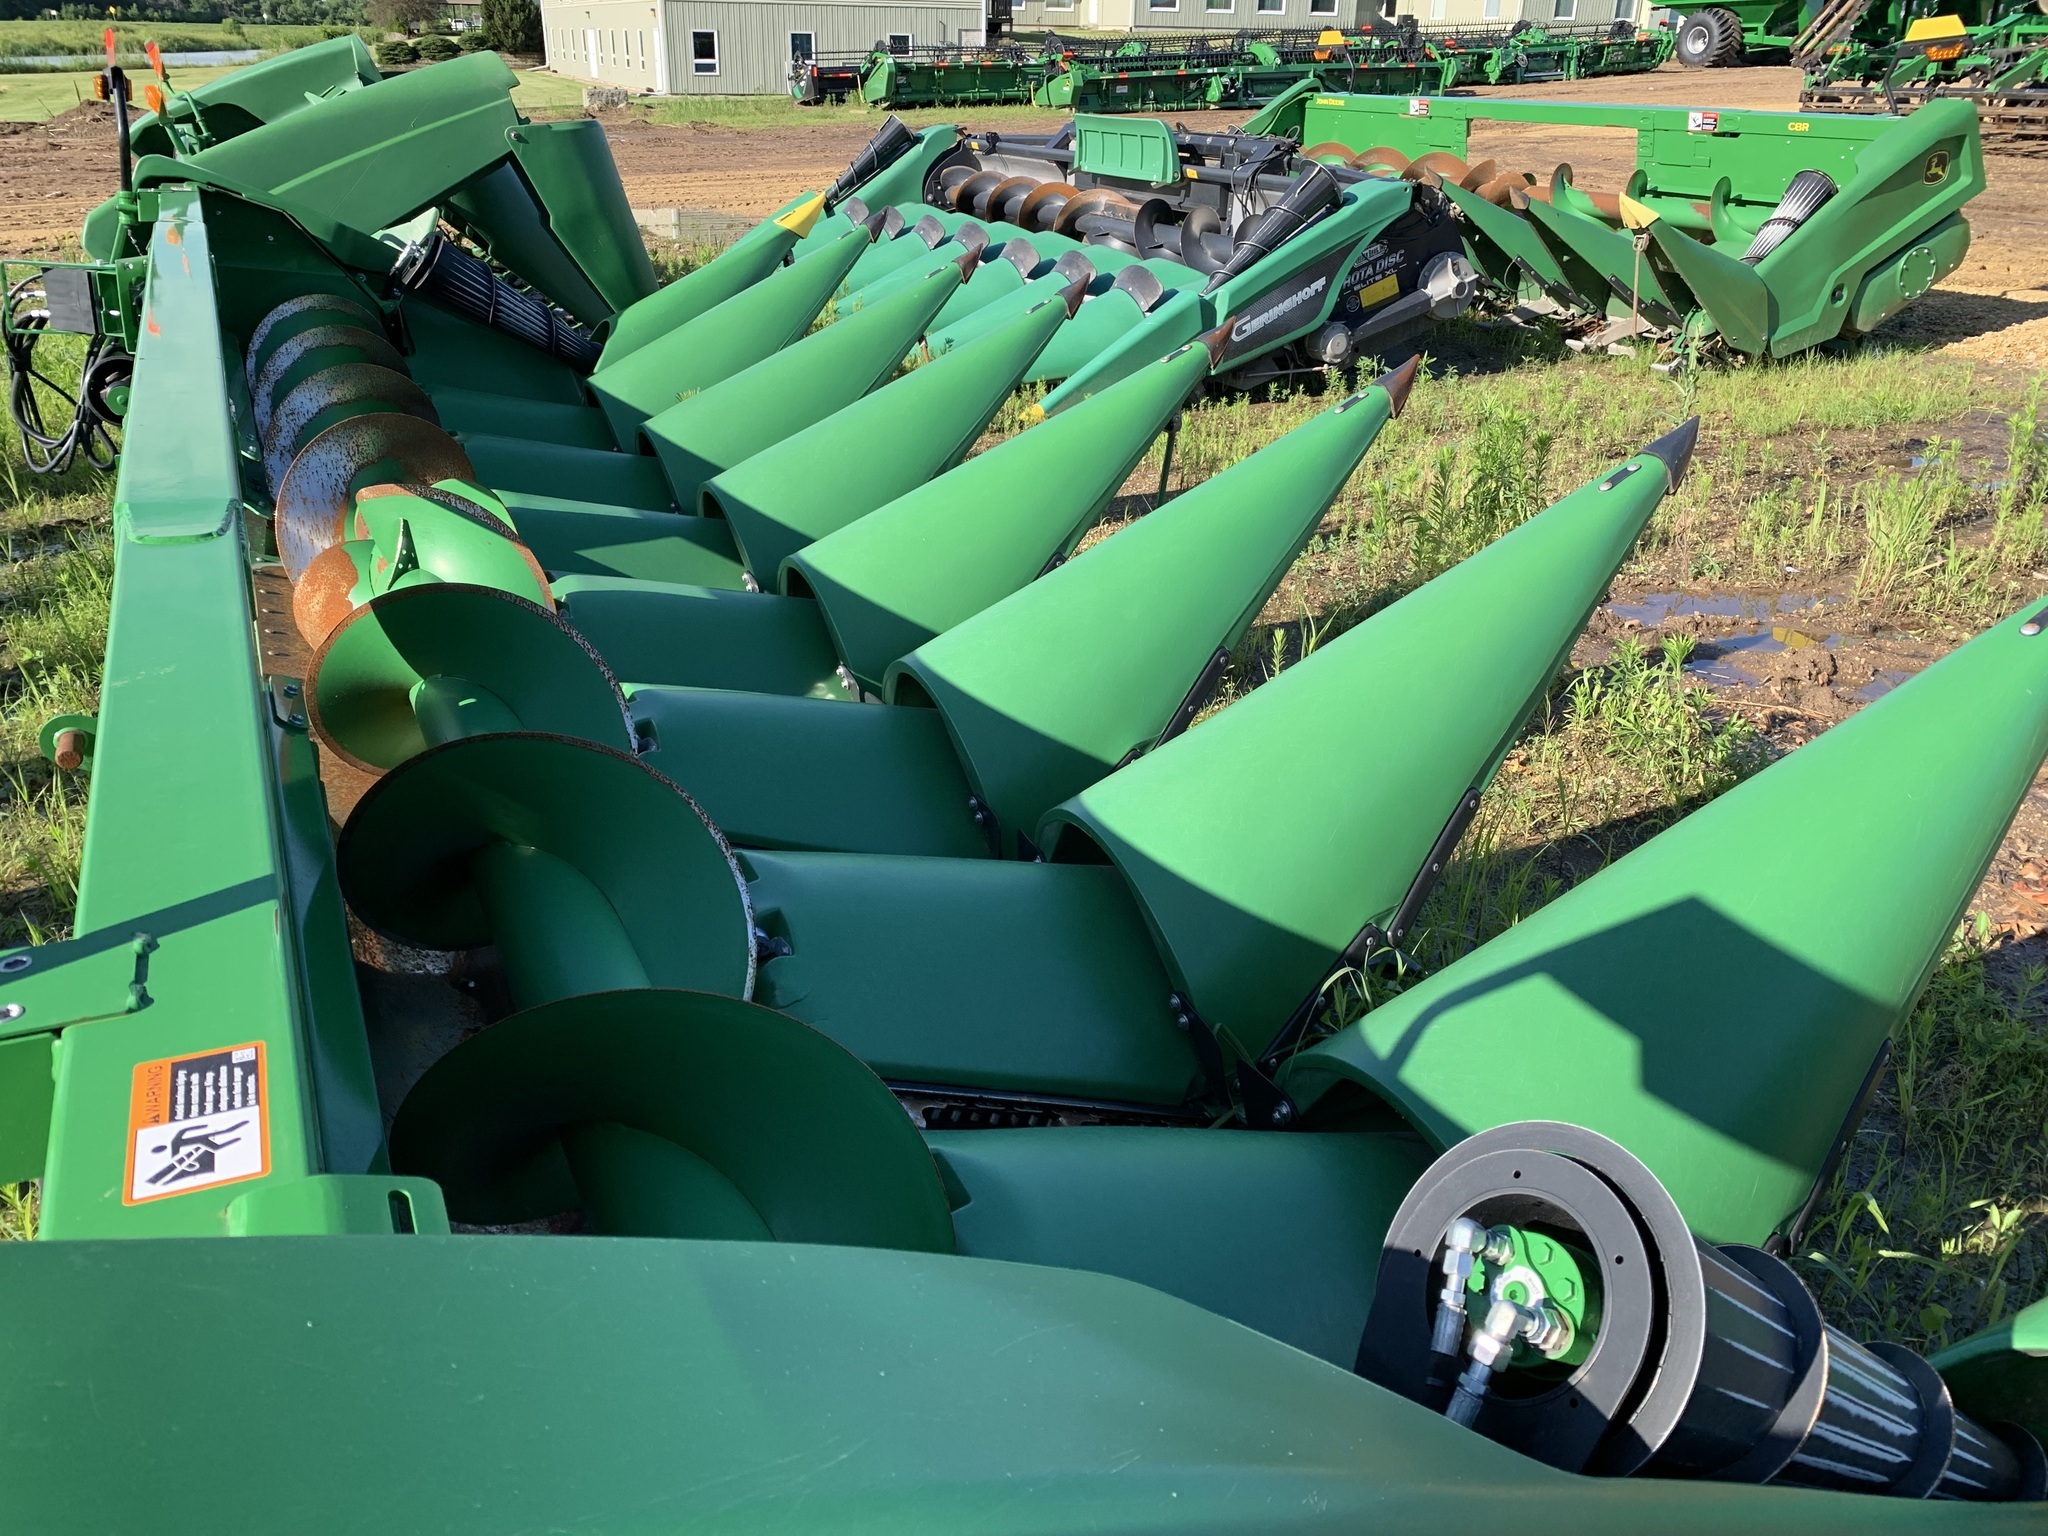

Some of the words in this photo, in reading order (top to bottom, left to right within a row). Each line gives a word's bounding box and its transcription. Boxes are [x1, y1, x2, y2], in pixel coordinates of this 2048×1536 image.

[1328, 98, 1345, 106] DEERE
[1376, 249, 1405, 274] DISC
[1353, 274, 1383, 291] ELITE
[1385, 268, 1398, 276] XL
[1231, 276, 1326, 342] GERINGHOFF
[145, 1065, 163, 1115] WARNING
[175, 1104, 185, 1120] Avoid
